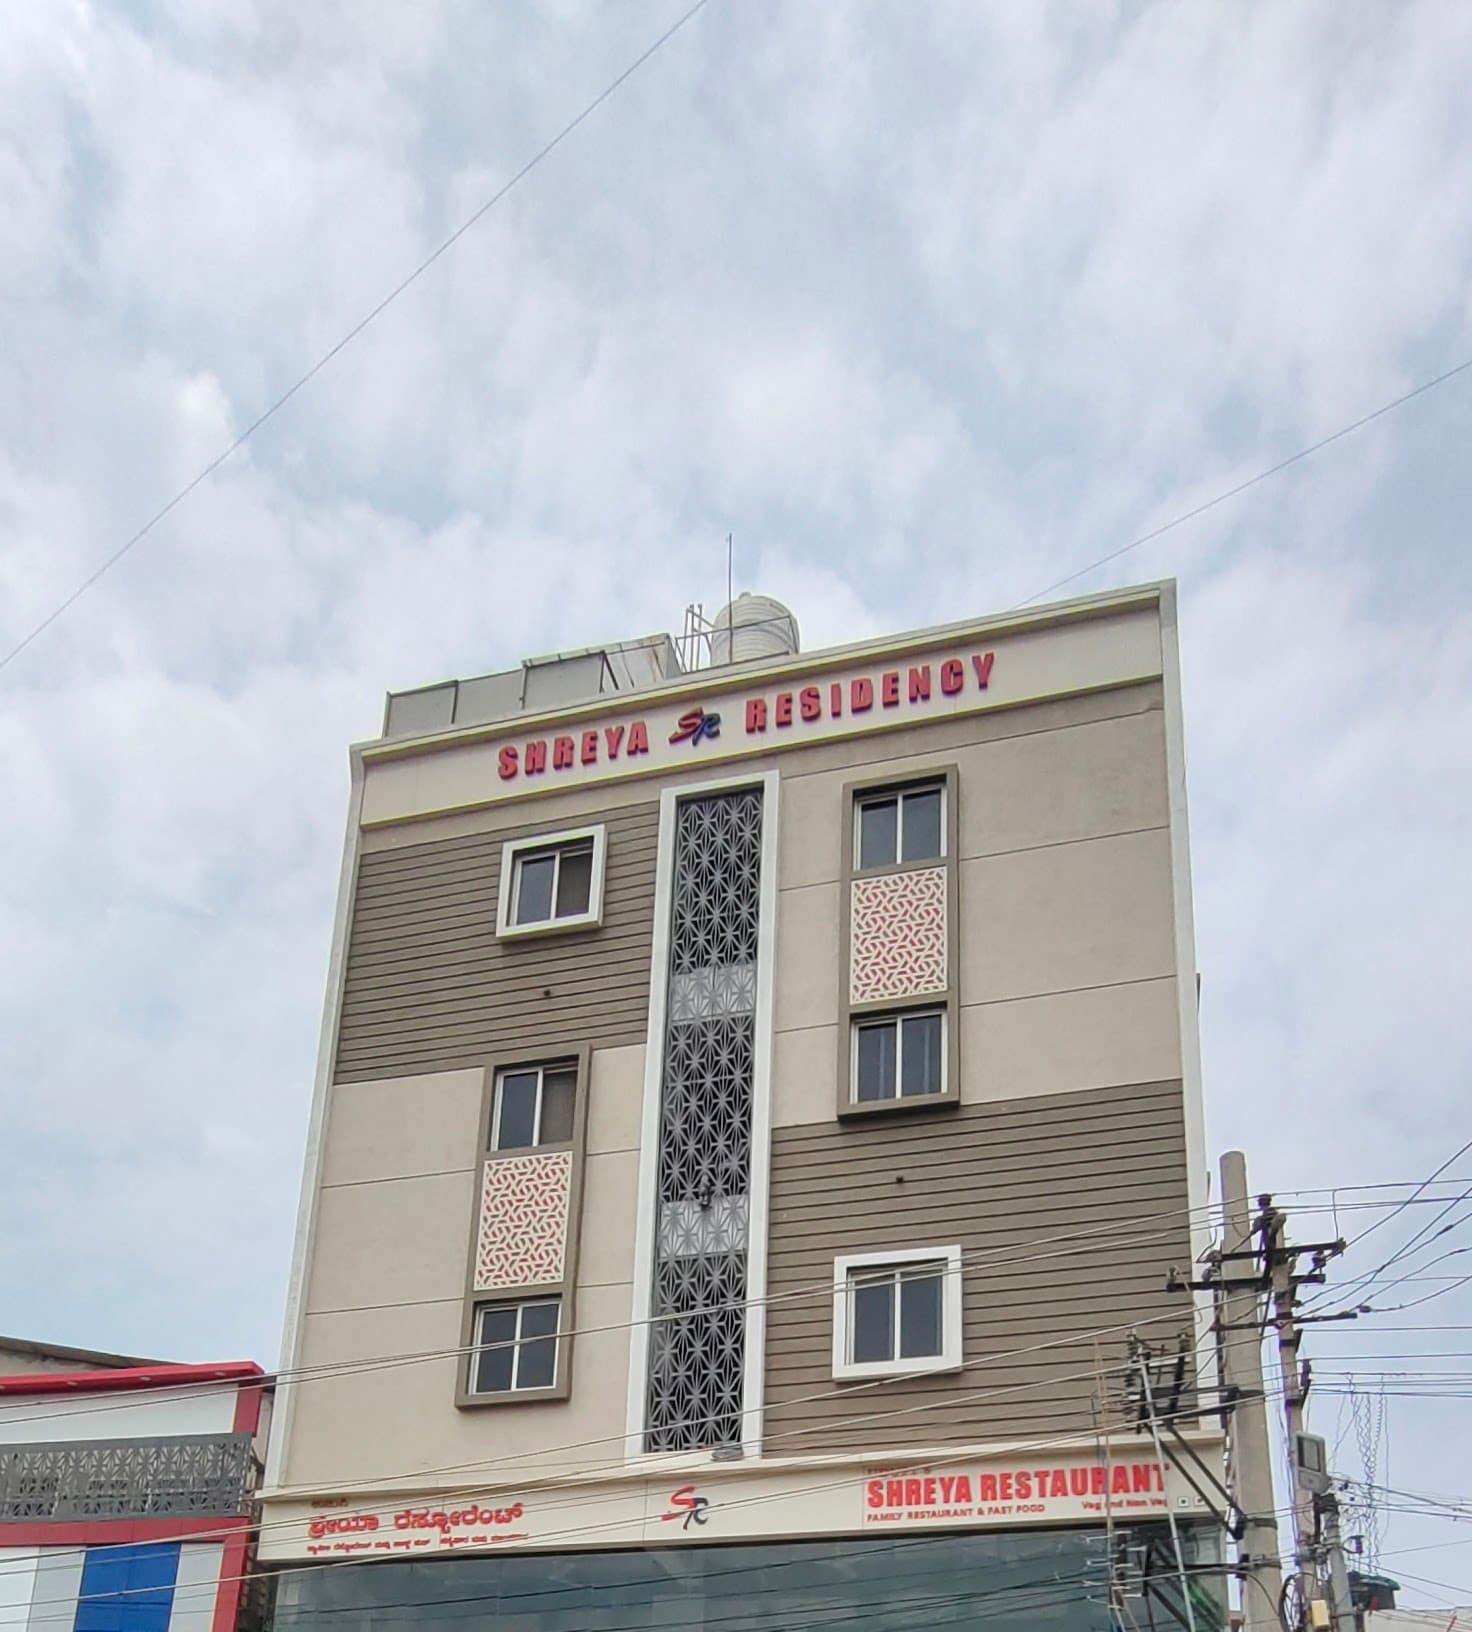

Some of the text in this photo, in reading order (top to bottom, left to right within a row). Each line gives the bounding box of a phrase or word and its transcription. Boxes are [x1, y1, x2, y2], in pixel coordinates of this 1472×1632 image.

[498, 721, 650, 780] SHREYA
[744, 652, 995, 733] RESIDENCY
[867, 1462, 1170, 1508] SHREYA RESTAURANT
[867, 1503, 1046, 1522] FAMILY RESTAURANT & FAST FOOD
